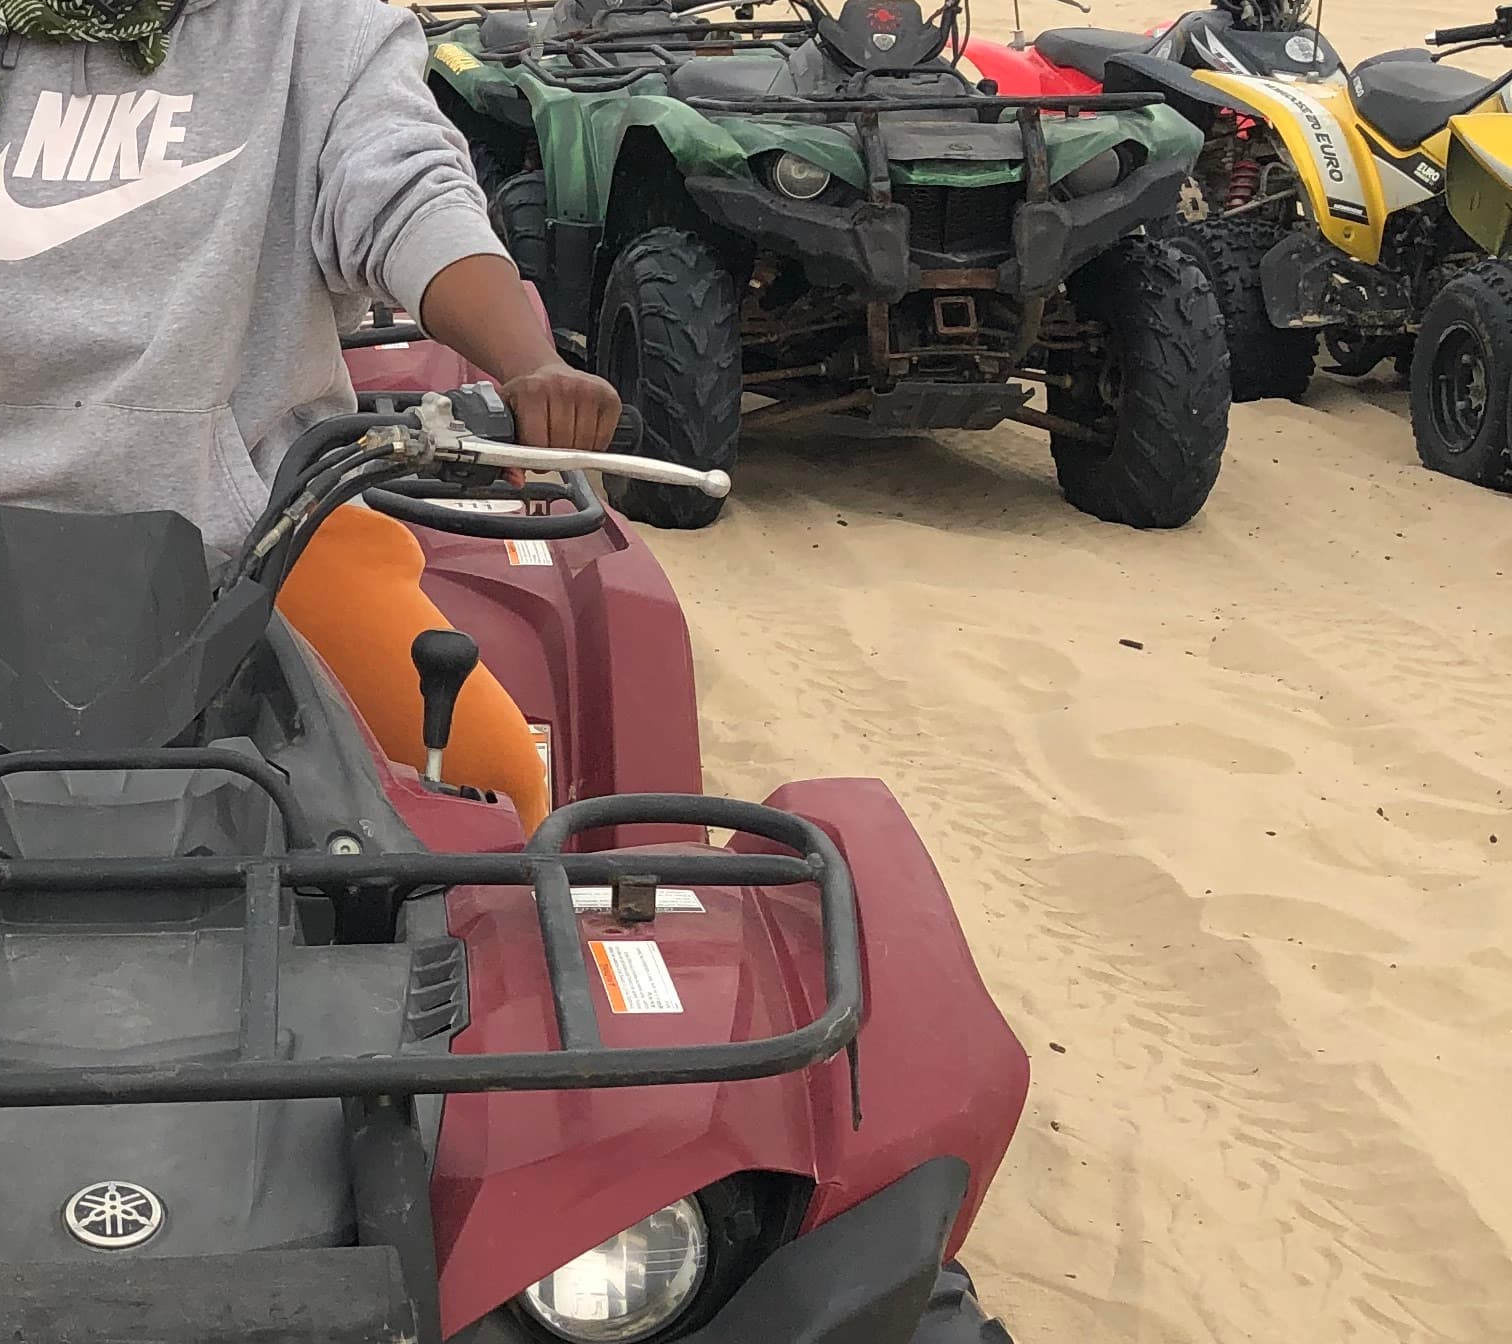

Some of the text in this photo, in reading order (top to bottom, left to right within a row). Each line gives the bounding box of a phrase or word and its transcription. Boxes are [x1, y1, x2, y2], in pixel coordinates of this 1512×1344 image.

[12, 89, 194, 182] NIKE
[1314, 132, 1344, 183] EURO
[1415, 161, 1441, 182] EURO
